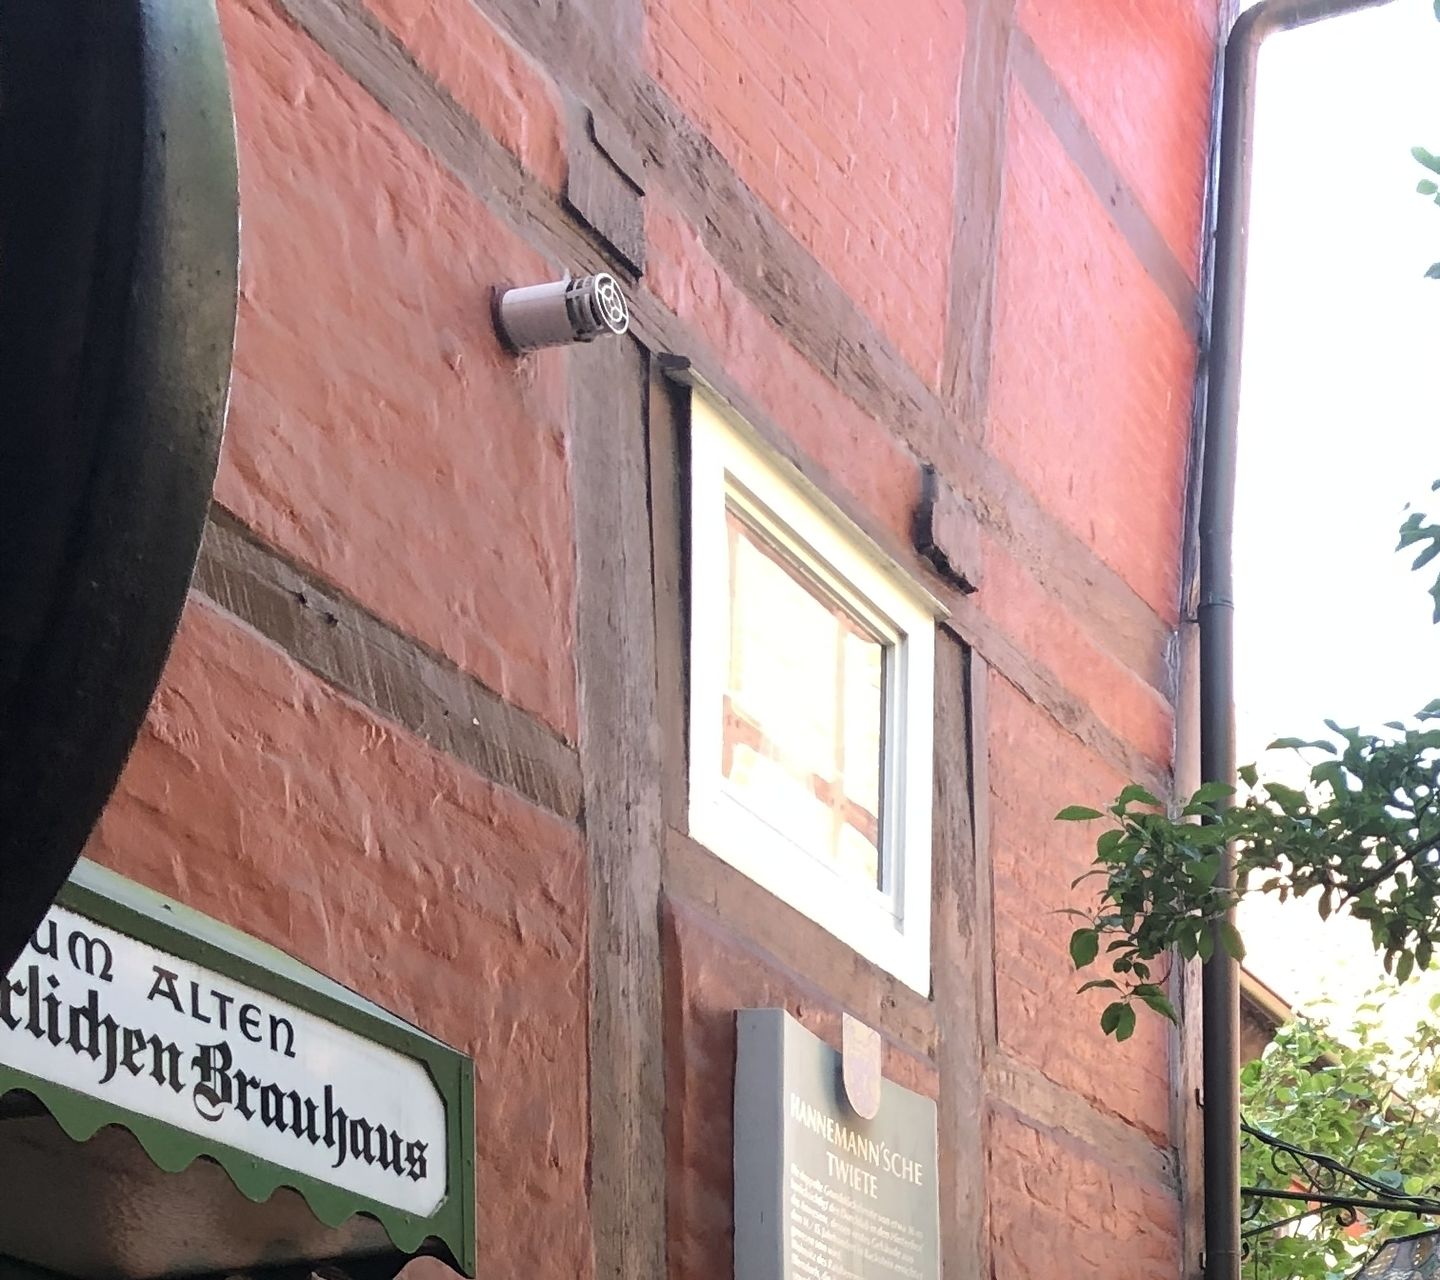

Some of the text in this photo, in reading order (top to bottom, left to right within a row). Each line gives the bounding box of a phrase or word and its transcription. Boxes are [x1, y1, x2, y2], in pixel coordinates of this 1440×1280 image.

[146, 964, 297, 1059] ALTEN
[190, 1041, 430, 1182] Brauhaus
[825, 1151, 878, 1200] TWIETE
